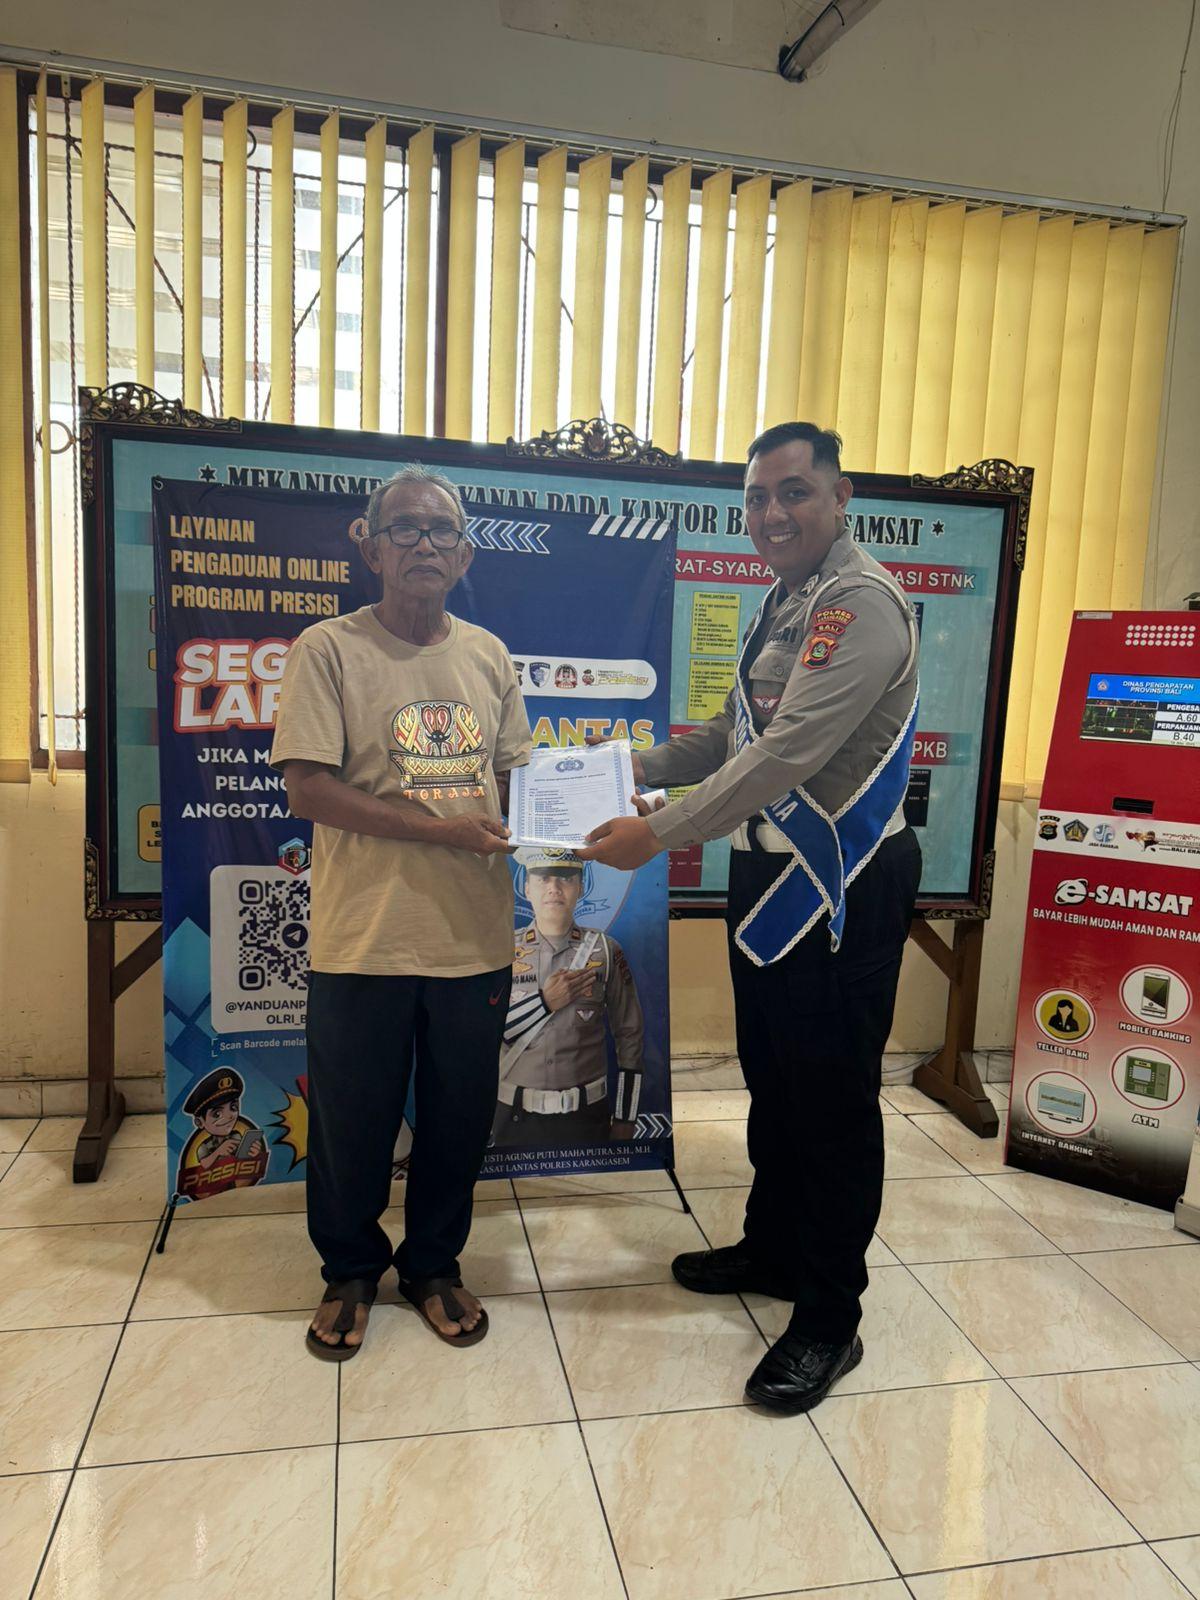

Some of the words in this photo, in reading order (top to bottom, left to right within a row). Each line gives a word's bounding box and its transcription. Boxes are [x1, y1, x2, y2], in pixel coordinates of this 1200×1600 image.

[457, 485, 537, 509] YANAN
[621, 498, 717, 534] KANTOR
[725, 506, 750, 535] B
[170, 515, 255, 543] LAYANAN
[171, 550, 281, 579] PENGADUAN
[287, 557, 350, 584] ONLINE
[673, 558, 775, 579] RAT-SYARA
[893, 570, 923, 586] ASI
[928, 571, 976, 589] STNK
[171, 584, 265, 613] PROGRAM
[270, 590, 339, 617] PRESISI
[817, 609, 852, 620] POLRES
[818, 624, 840, 632] BALI
[180, 642, 287, 684] SEG
[1122, 680, 1144, 688] DINAS
[1145, 681, 1195, 690] PENDAPATAN
[1130, 686, 1164, 694] PROVINSI
[1166, 703, 1200, 712] PENGESA
[1176, 713, 1198, 723] A.60
[532, 717, 655, 751] ANTAS
[1173, 732, 1195, 741] B.40
[197, 748, 250, 764] JIKA
[254, 750, 269, 764] M
[911, 740, 947, 758] PKB
[403, 786, 486, 800] TORAJA
[1033, 908, 1063, 922] BAYAR
[1064, 913, 1088, 926] LEBIH
[1089, 917, 1124, 931] MUDAH
[1125, 922, 1154, 936] AMAN
[1156, 927, 1178, 939] DAN
[1179, 930, 1200, 943] RAM
[266, 1014, 307, 1026] OLRI_B
[1119, 1022, 1150, 1035] MOBILE
[1151, 1028, 1191, 1043] BANKING
[220, 1042, 242, 1051] Scan
[244, 1038, 280, 1049] Barcode
[1037, 1042, 1064, 1055] TELLER
[1066, 1048, 1089, 1060] BANK
[1131, 1114, 1160, 1129] ATM
[1021, 1131, 1056, 1147] INTERNET
[1058, 1142, 1094, 1156] BANKING
[484, 1152, 504, 1164] USTI
[504, 1151, 534, 1161] AGUNG
[536, 1150, 560, 1160] PUTU
[560, 1149, 586, 1158] MAHA
[183, 1160, 260, 1190] PRESISI
[480, 1163, 504, 1175] ASAT
[505, 1161, 538, 1172] LANTAS
[540, 1160, 572, 1170] POLRES
[573, 1157, 631, 1168] KARANGASEM
